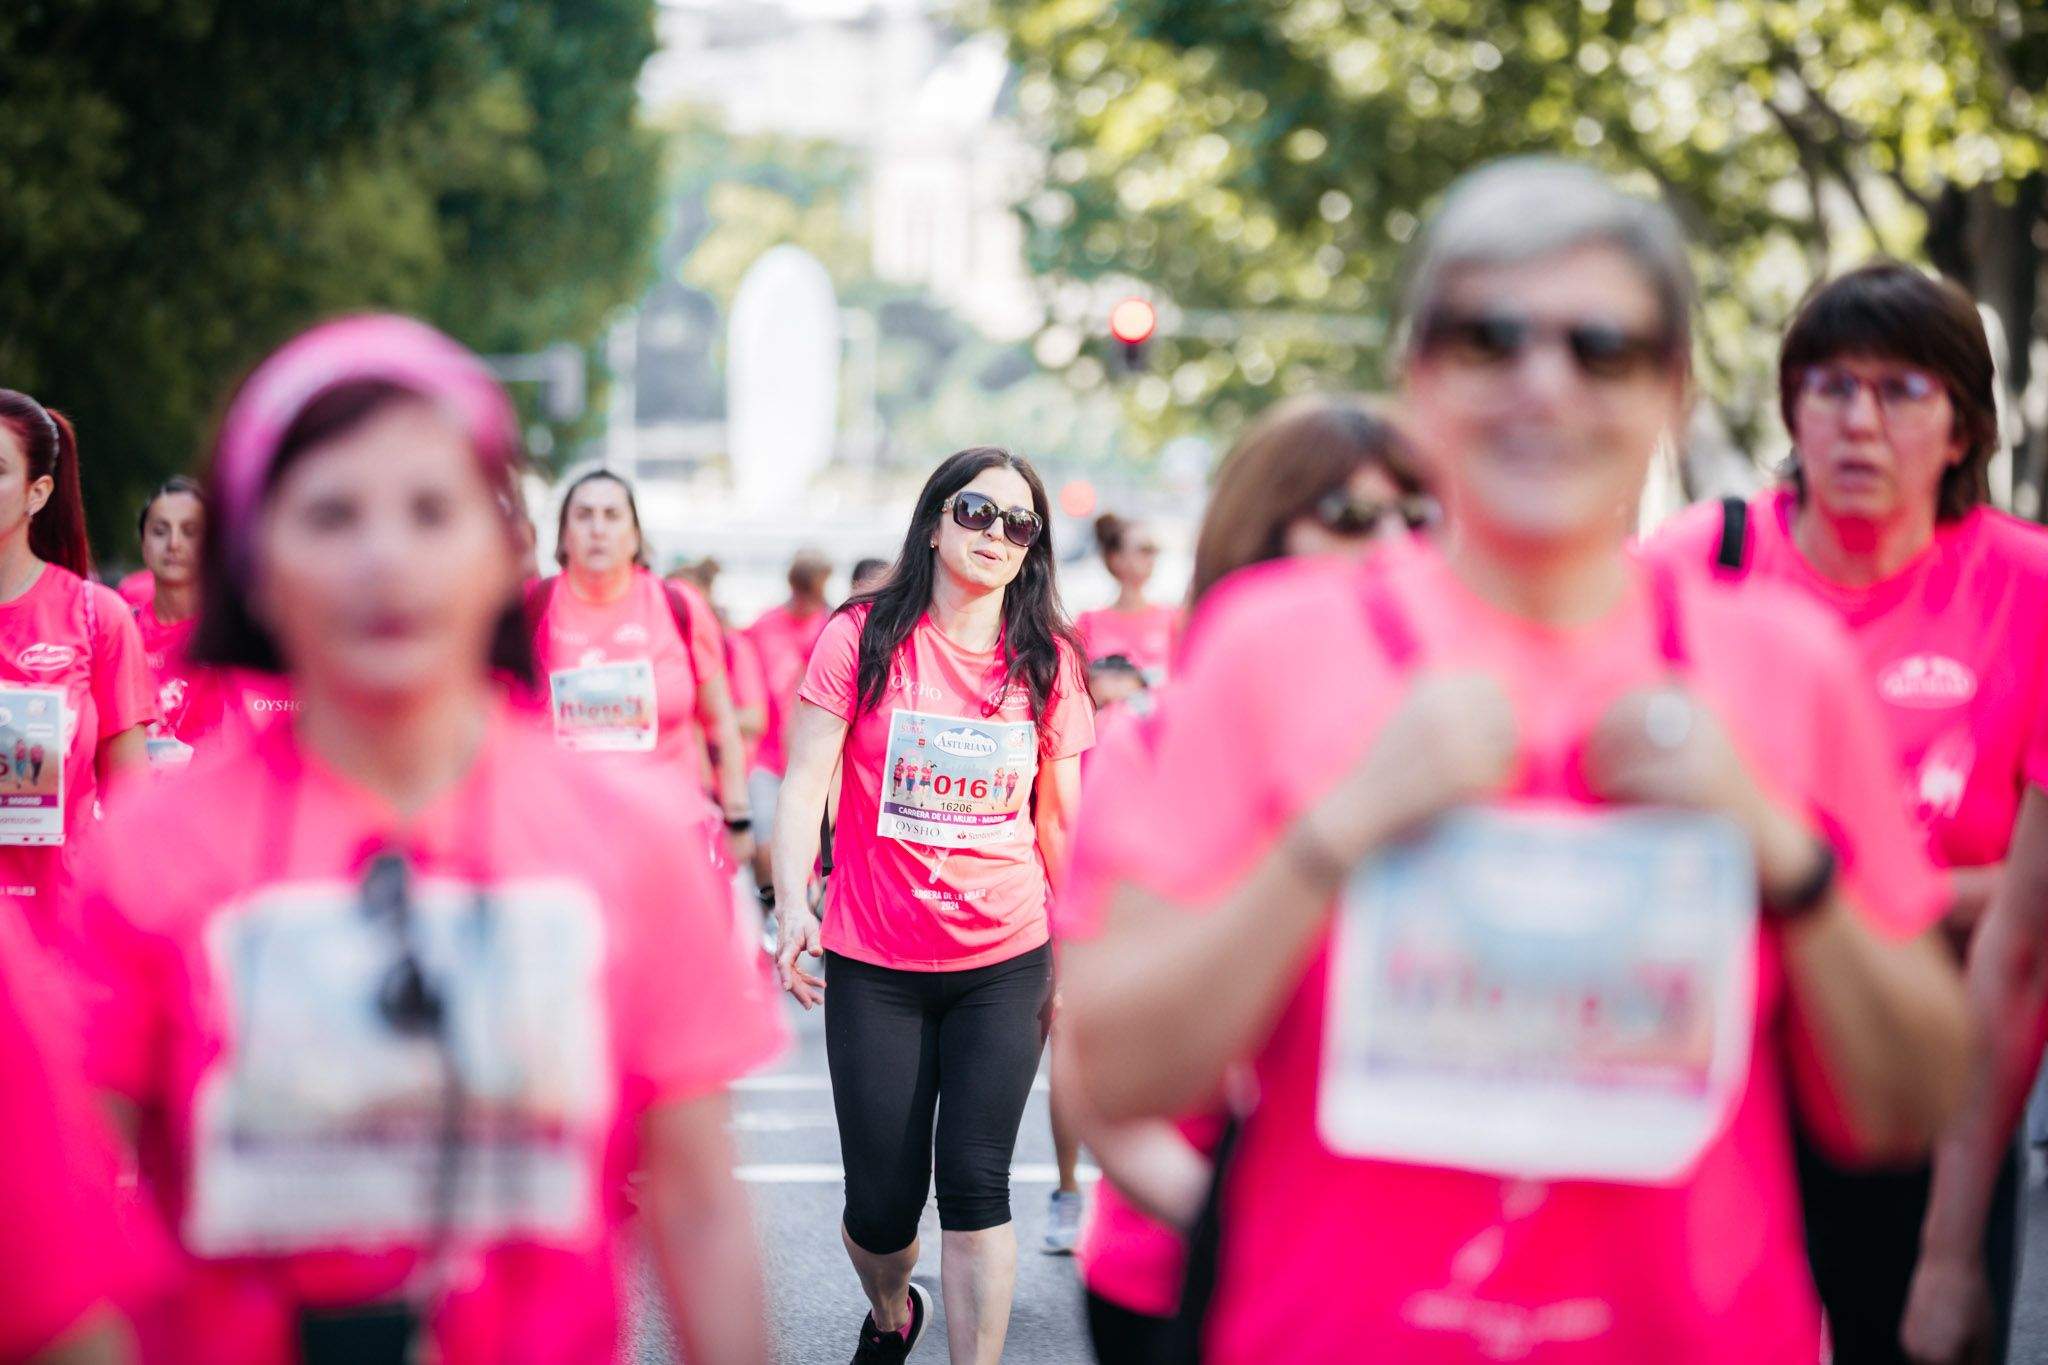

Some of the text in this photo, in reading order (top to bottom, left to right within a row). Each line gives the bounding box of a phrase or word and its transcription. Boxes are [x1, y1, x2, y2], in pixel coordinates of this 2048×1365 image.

[891, 674, 942, 700] OYSHO
[939, 736, 993, 753] ASTURIANA
[933, 775, 988, 799] 016
[898, 806, 930, 819] CARRERA
[931, 812, 941, 821] DE
[942, 813, 952, 822] LA
[941, 802, 972, 813] 16206
[896, 820, 940, 836] OYSHO
